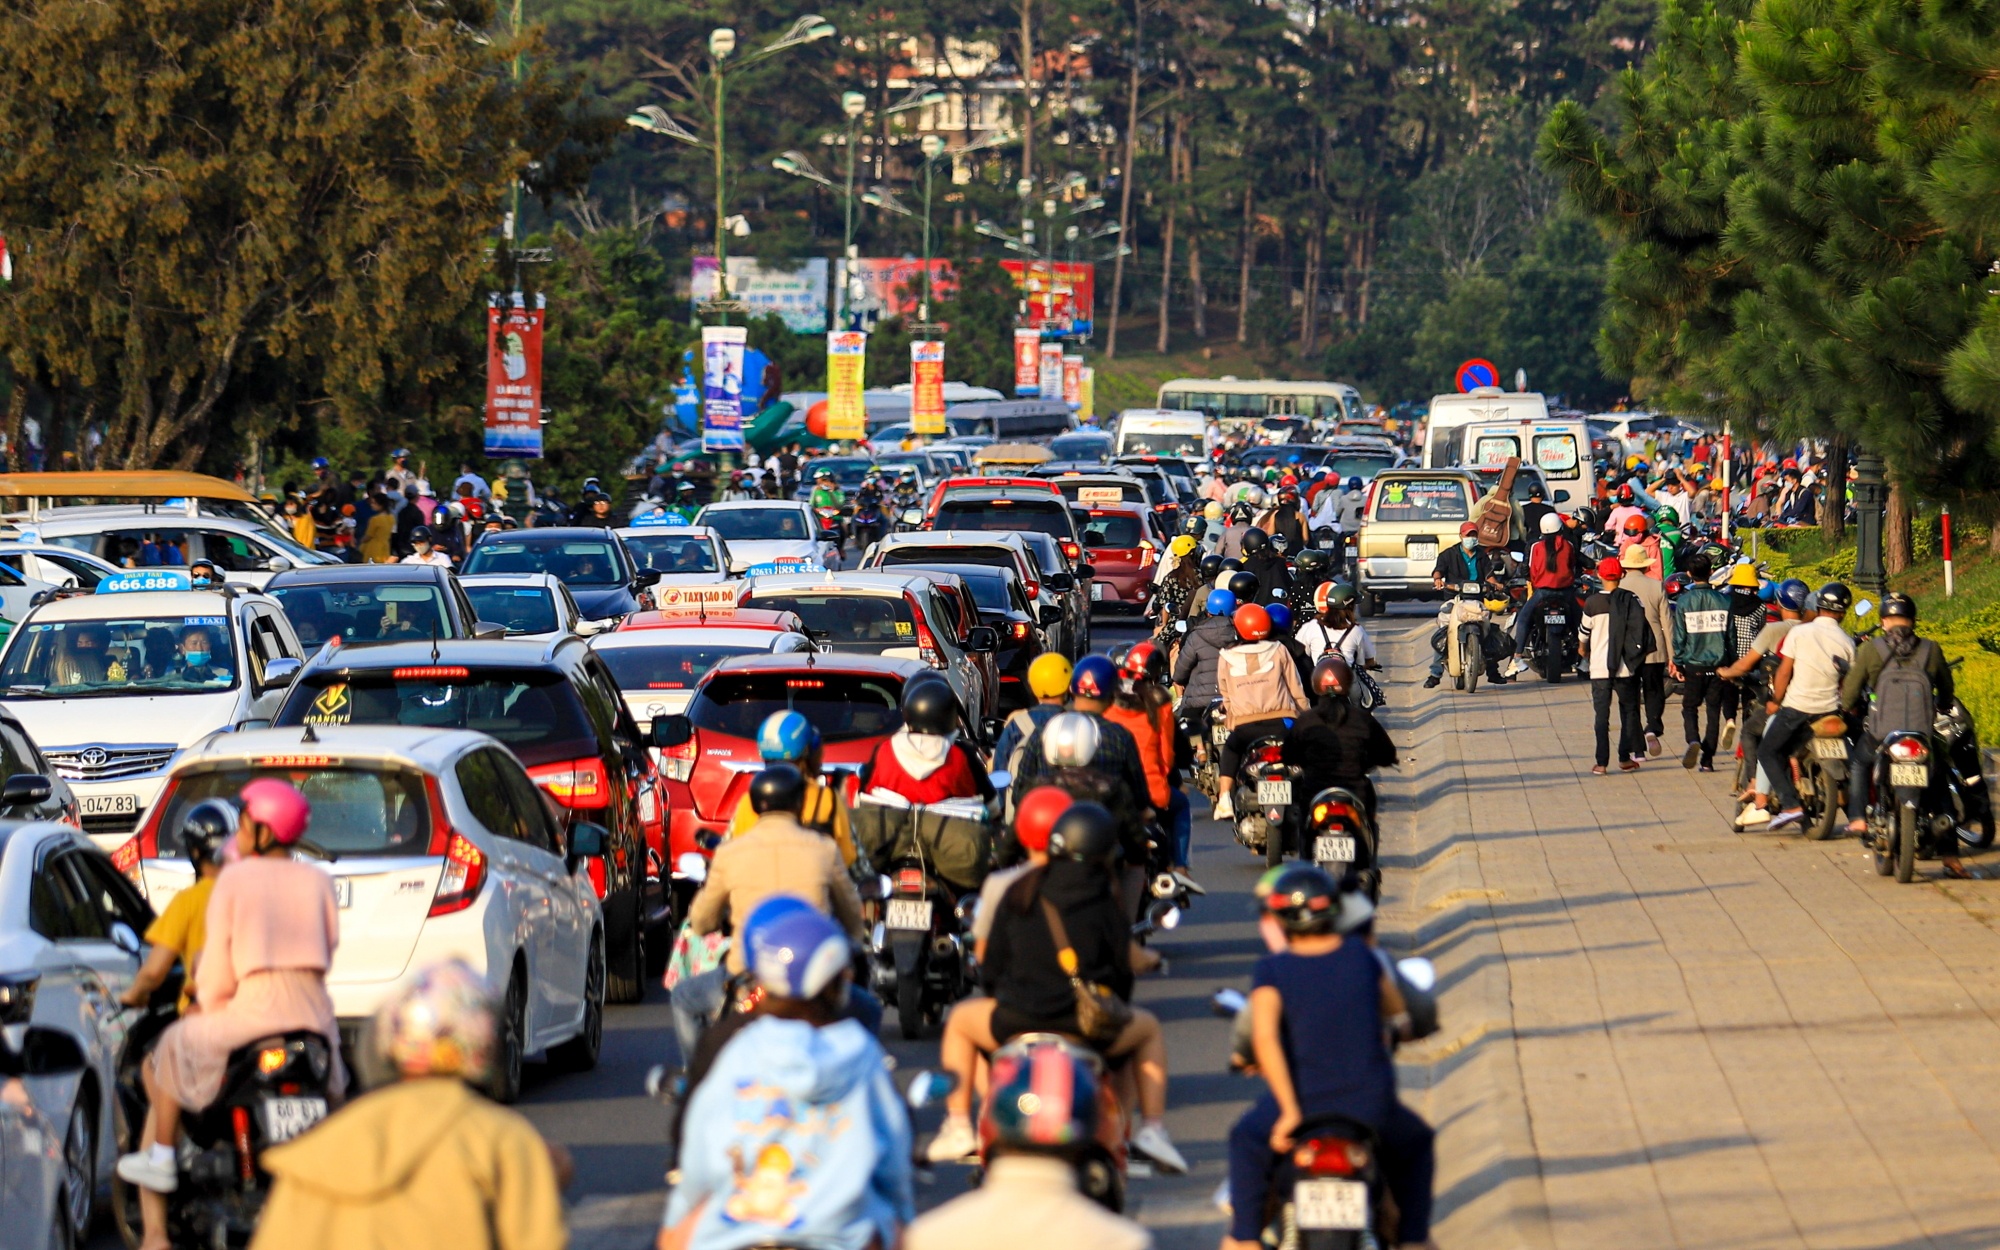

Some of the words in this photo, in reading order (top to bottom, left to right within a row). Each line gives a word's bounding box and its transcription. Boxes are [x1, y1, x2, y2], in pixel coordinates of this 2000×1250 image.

[750, 568, 772, 576] 02633
[108, 577, 178, 591] 666.888
[704, 591, 720, 602] SAO
[1260, 793, 1289, 802] 671.31
